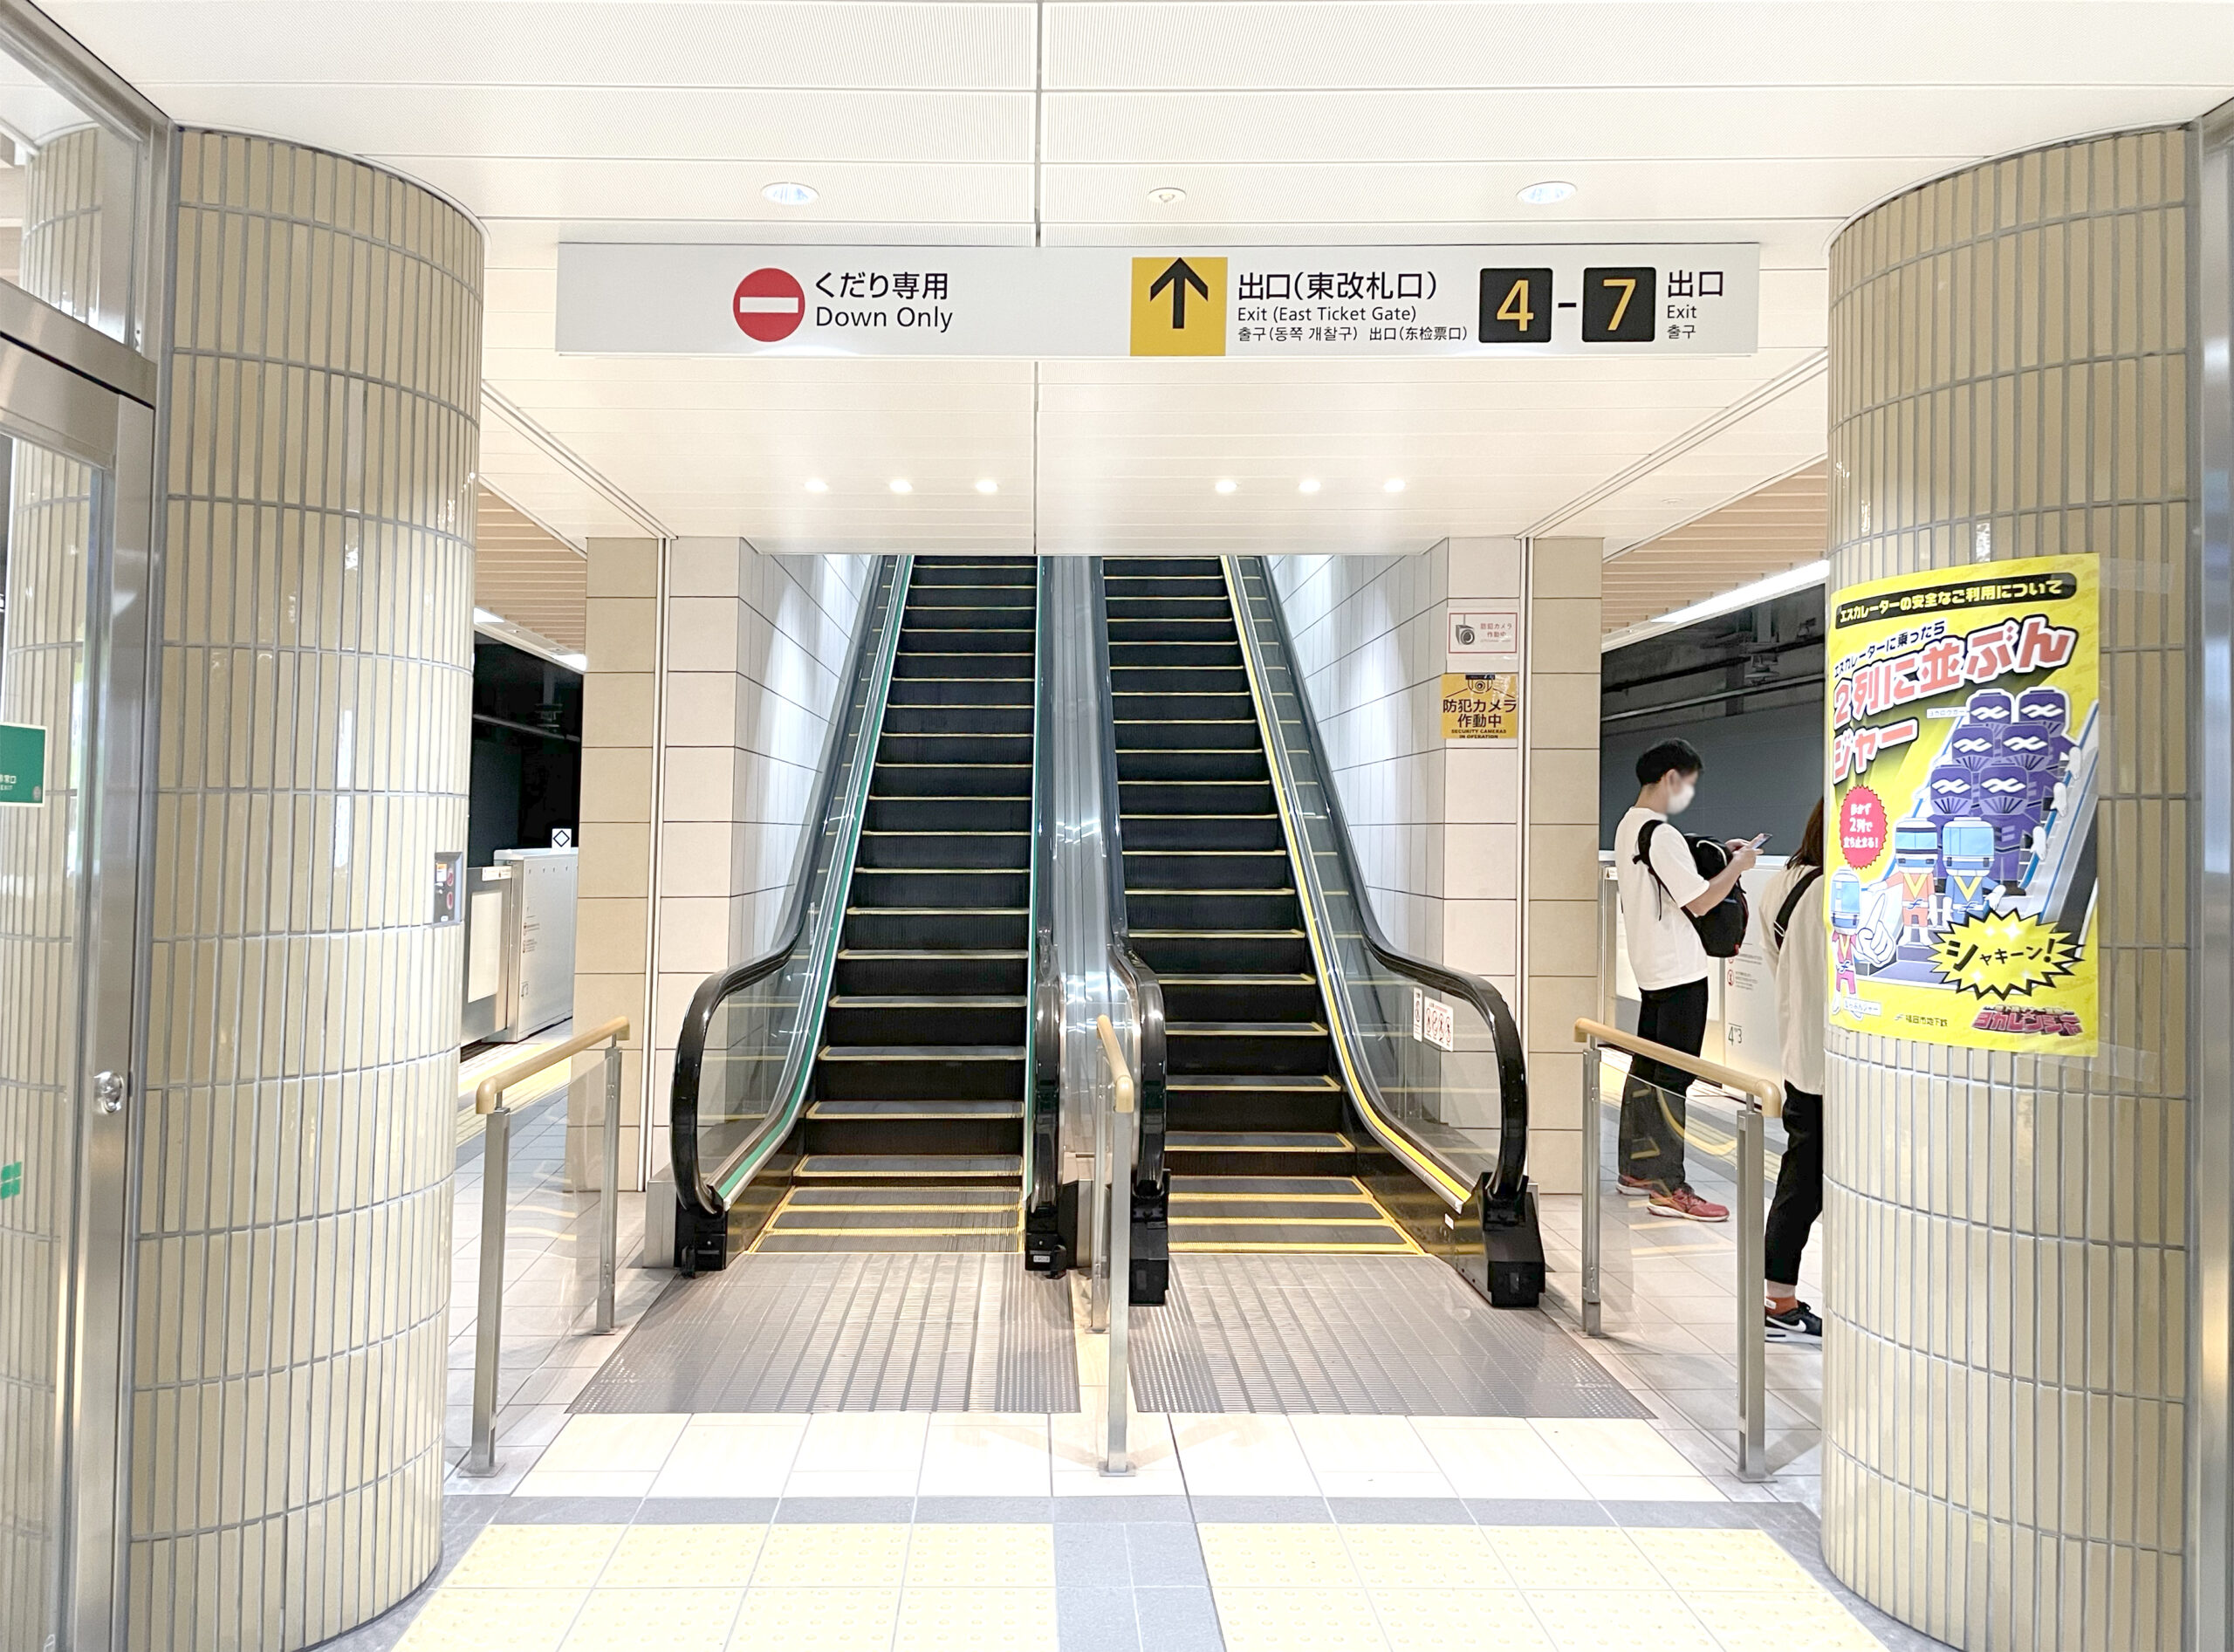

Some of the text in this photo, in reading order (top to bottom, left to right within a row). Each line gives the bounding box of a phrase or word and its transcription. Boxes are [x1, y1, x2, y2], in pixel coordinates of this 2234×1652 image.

[815, 271, 949, 300] くだり専用
[1237, 271, 1437, 301] 出口(東改札口)
[1667, 269, 1724, 298] 出口
[1237, 305, 1416, 324] Exit (East Ticket Gate)
[1496, 278, 1535, 332] 4
[1601, 278, 1638, 332] 7
[1667, 304, 1698, 320] Exit
[816, 306, 954, 334] Down Only
[1237, 326, 1359, 342] 출구(동쪽 개찰구)
[1368, 326, 1468, 341] 出口(东检票口)
[1666, 324, 1697, 340] 출구
[1840, 579, 2064, 623] エスカレーターの安全なご利用について
[1834, 620, 1945, 678] エスカレーターに乗ったら
[1834, 618, 2073, 727] 2列に並ぶん
[1443, 699, 1517, 713] 防犯カメラ
[1457, 713, 1502, 729] 作動中
[1945, 938, 2056, 972] シャキーン!
